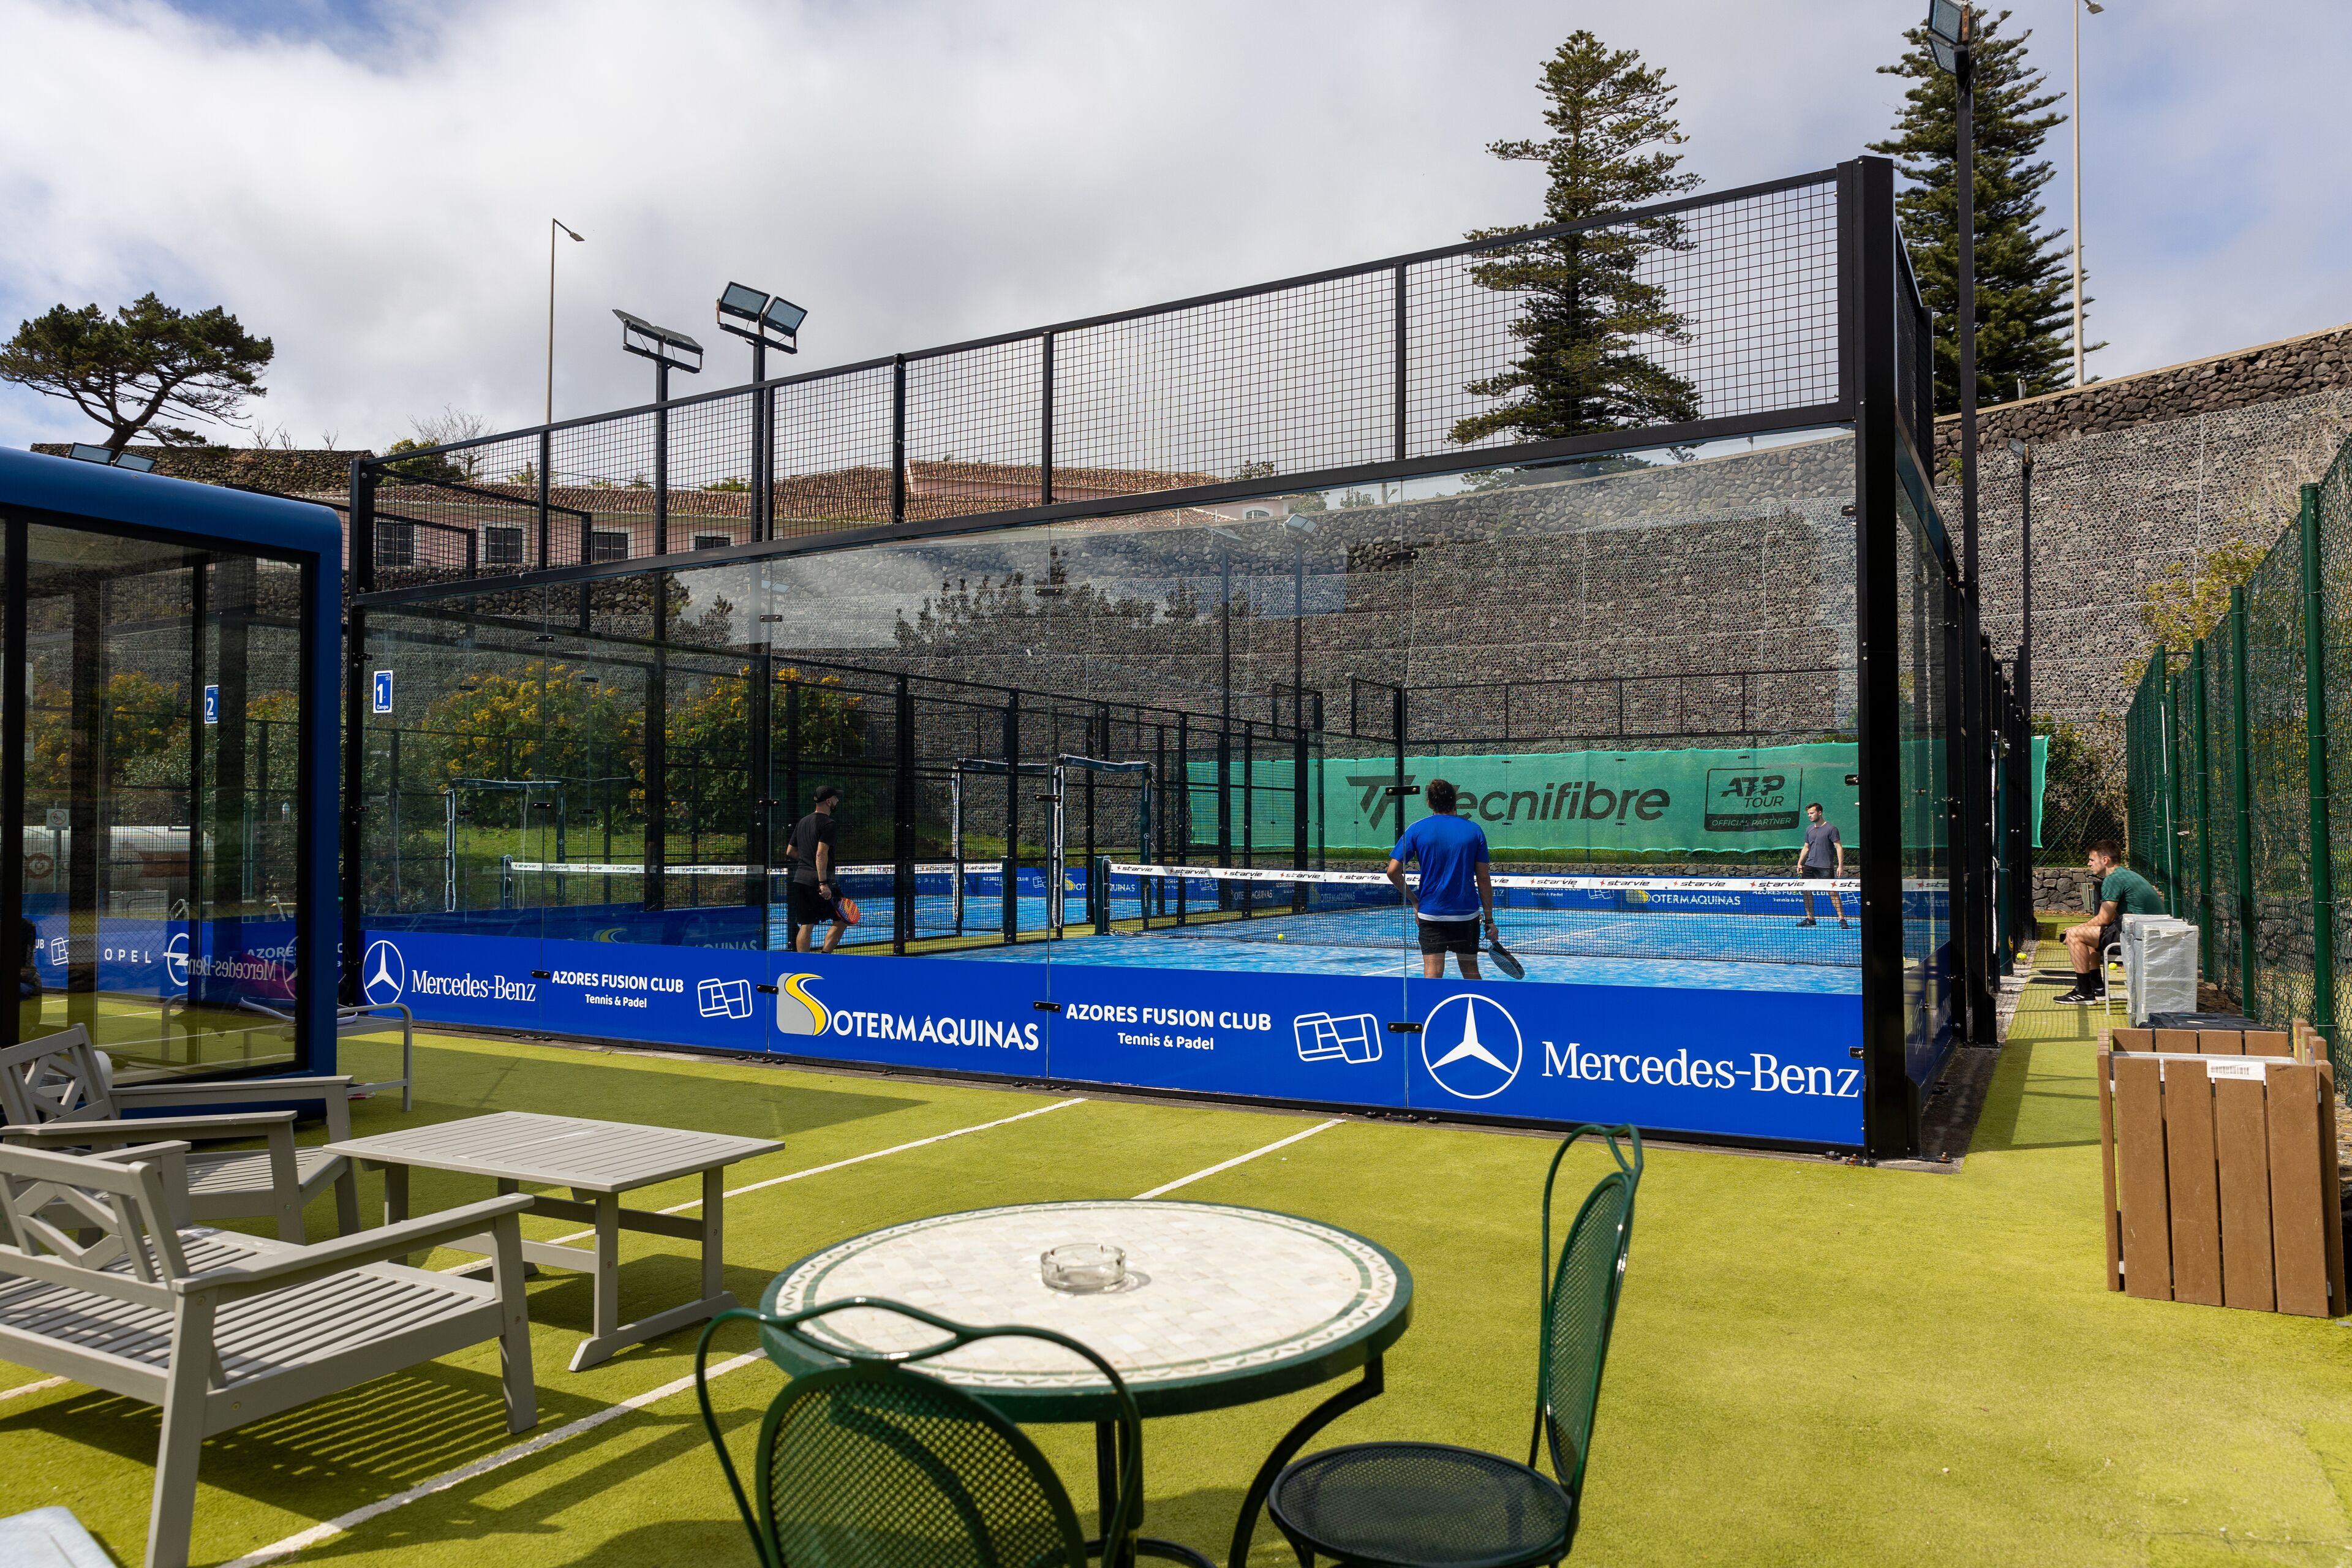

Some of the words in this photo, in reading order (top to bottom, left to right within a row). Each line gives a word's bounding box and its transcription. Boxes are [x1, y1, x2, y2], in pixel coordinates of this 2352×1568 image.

[377, 684, 383, 704] 1
[207, 697, 214, 716] 2
[1718, 775, 1785, 797] ATP
[1426, 781, 1671, 821] ecnifibre
[1744, 796, 1784, 809] TOUR
[35, 939, 45, 949] UB
[247, 946, 296, 959] AZORE
[104, 948, 152, 964] OPEL
[411, 970, 537, 1002] Mercedes-Benz
[552, 970, 599, 987] AZORES
[601, 974, 647, 990] FUSION
[650, 978, 684, 993] CLUB
[585, 993, 613, 1006] Tennis
[614, 996, 621, 1006] &
[623, 997, 647, 1008] Padel
[1066, 1003, 1138, 1023] AZORES
[1142, 1008, 1214, 1028] FUSION
[1219, 1011, 1272, 1031] CLUB
[1117, 1032, 1161, 1047] Tennis
[1163, 1035, 1174, 1048] &
[1177, 1036, 1214, 1050] Padel
[1542, 1041, 1860, 1098] Mercedes-Benz
